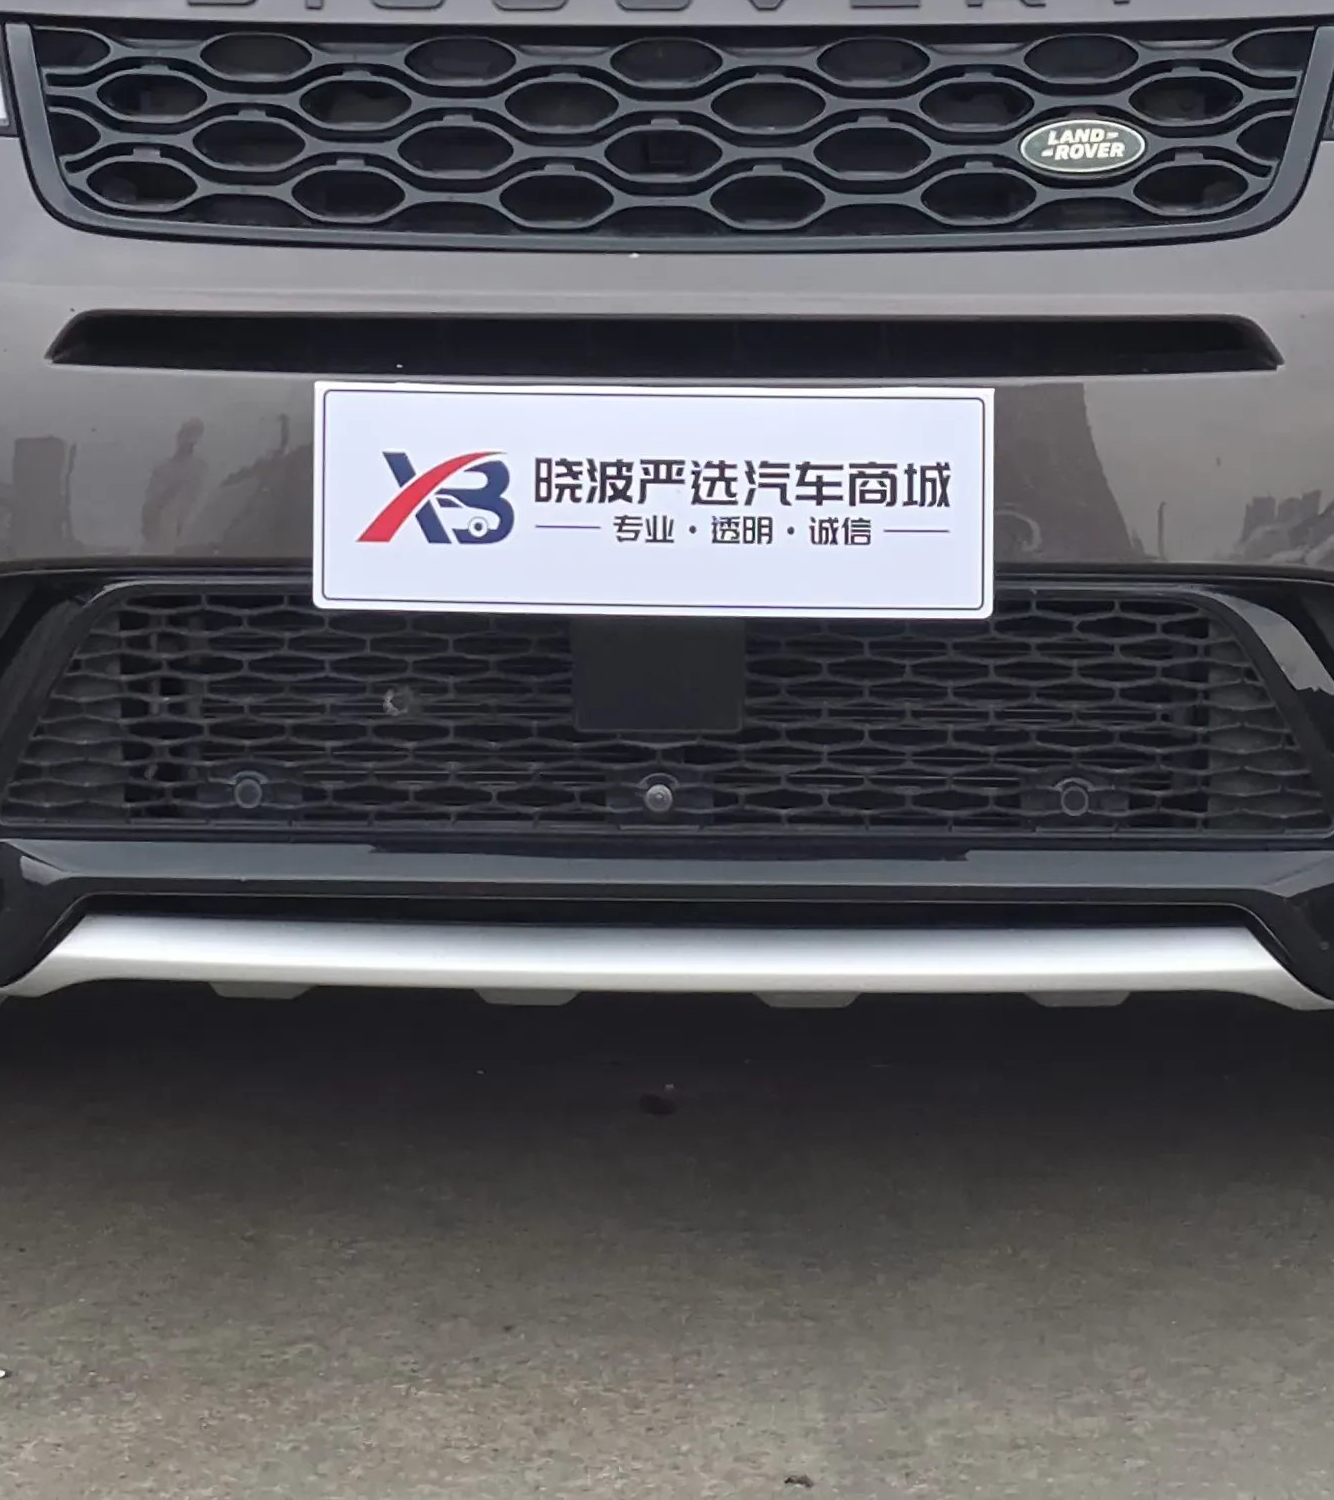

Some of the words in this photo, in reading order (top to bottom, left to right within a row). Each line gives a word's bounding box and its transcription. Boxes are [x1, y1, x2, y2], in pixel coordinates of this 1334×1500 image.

[1047, 127, 1105, 145] LAND
[1054, 141, 1126, 160] ROVER
[533, 457, 952, 509] 晓波严选汽车商城
